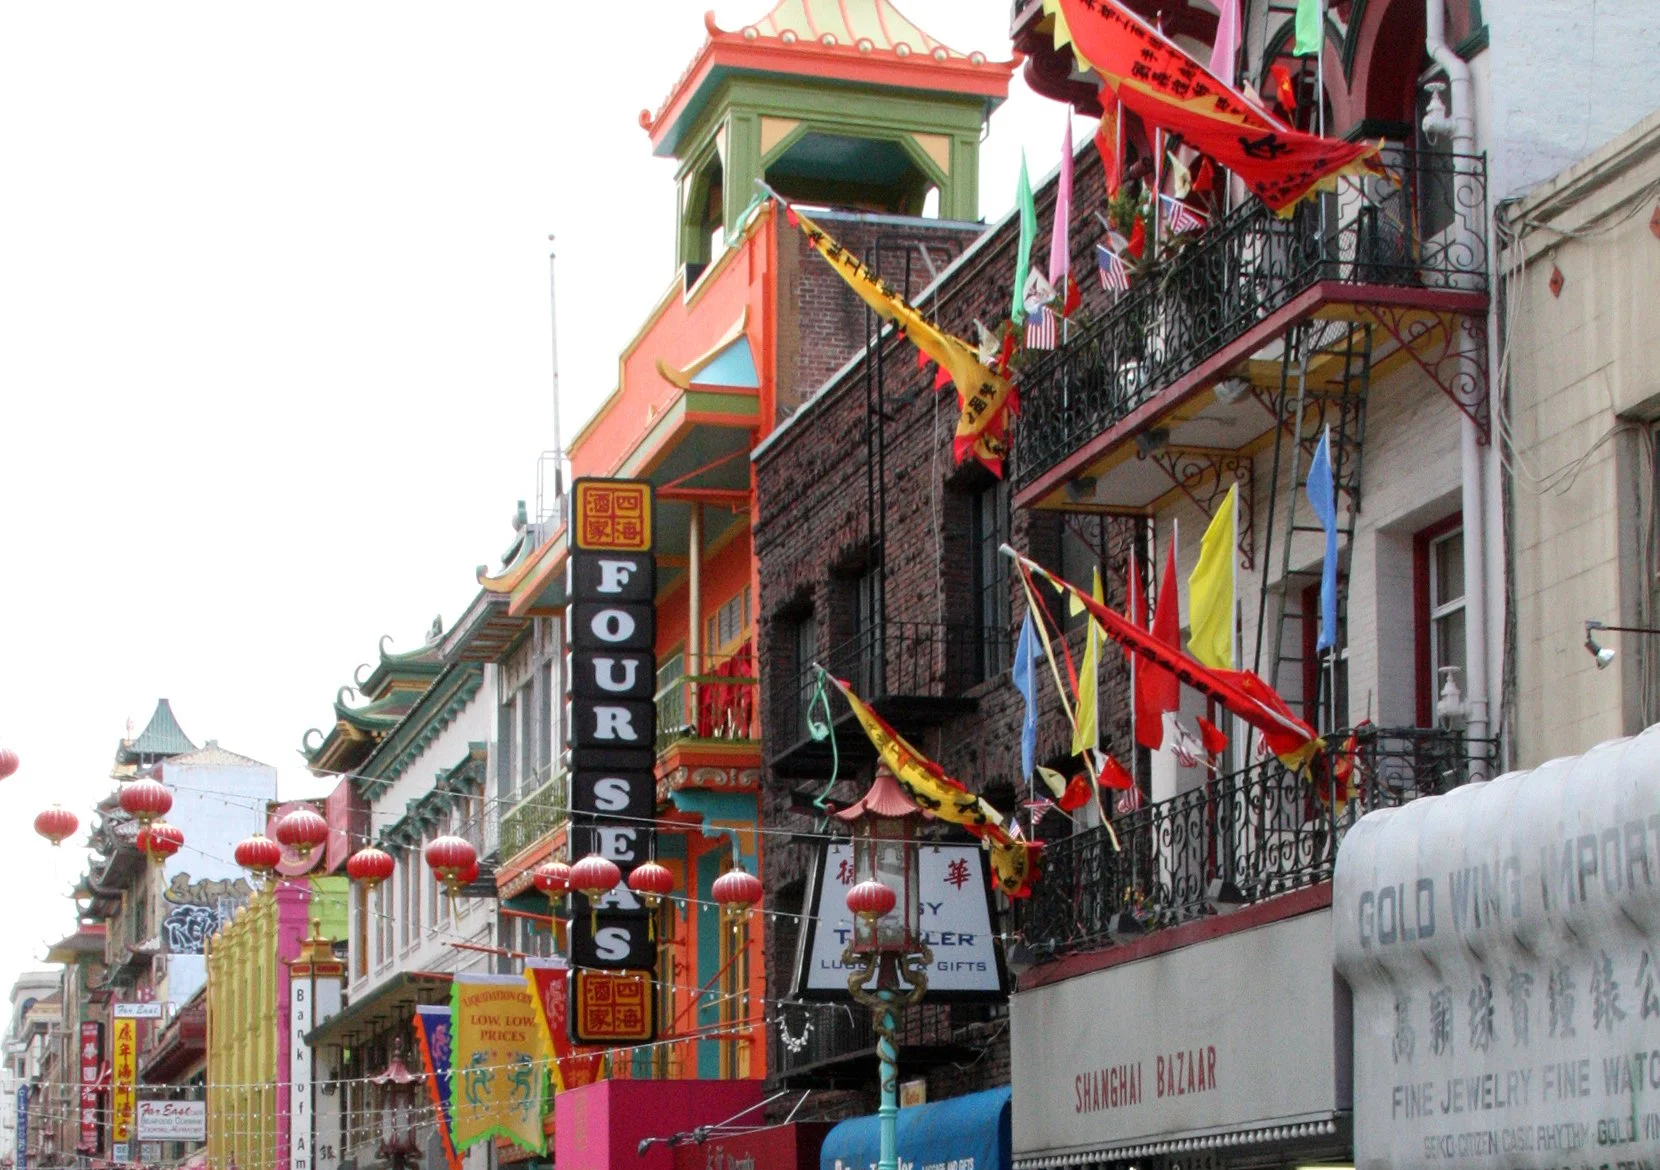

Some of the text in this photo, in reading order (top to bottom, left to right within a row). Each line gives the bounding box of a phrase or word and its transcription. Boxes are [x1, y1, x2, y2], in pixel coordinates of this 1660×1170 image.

[590, 560, 639, 741] FOUR
[593, 777, 641, 961] SEAS
[1359, 877, 1435, 949] GOLD
[1449, 854, 1522, 933] WING
[833, 928, 975, 946] TLER
[937, 961, 987, 973] GIFTS
[296, 989, 305, 1061] Bank
[480, 1030, 526, 1042] PRICES
[161, 1103, 193, 1116] East
[297, 1083, 305, 1115] of
[1075, 1045, 1217, 1114] SHANGHAI BAZAAR
[1392, 1081, 1433, 1120] FINE
[1440, 1066, 1533, 1115] JEWELRY
[1542, 1058, 1592, 1102] FINE
